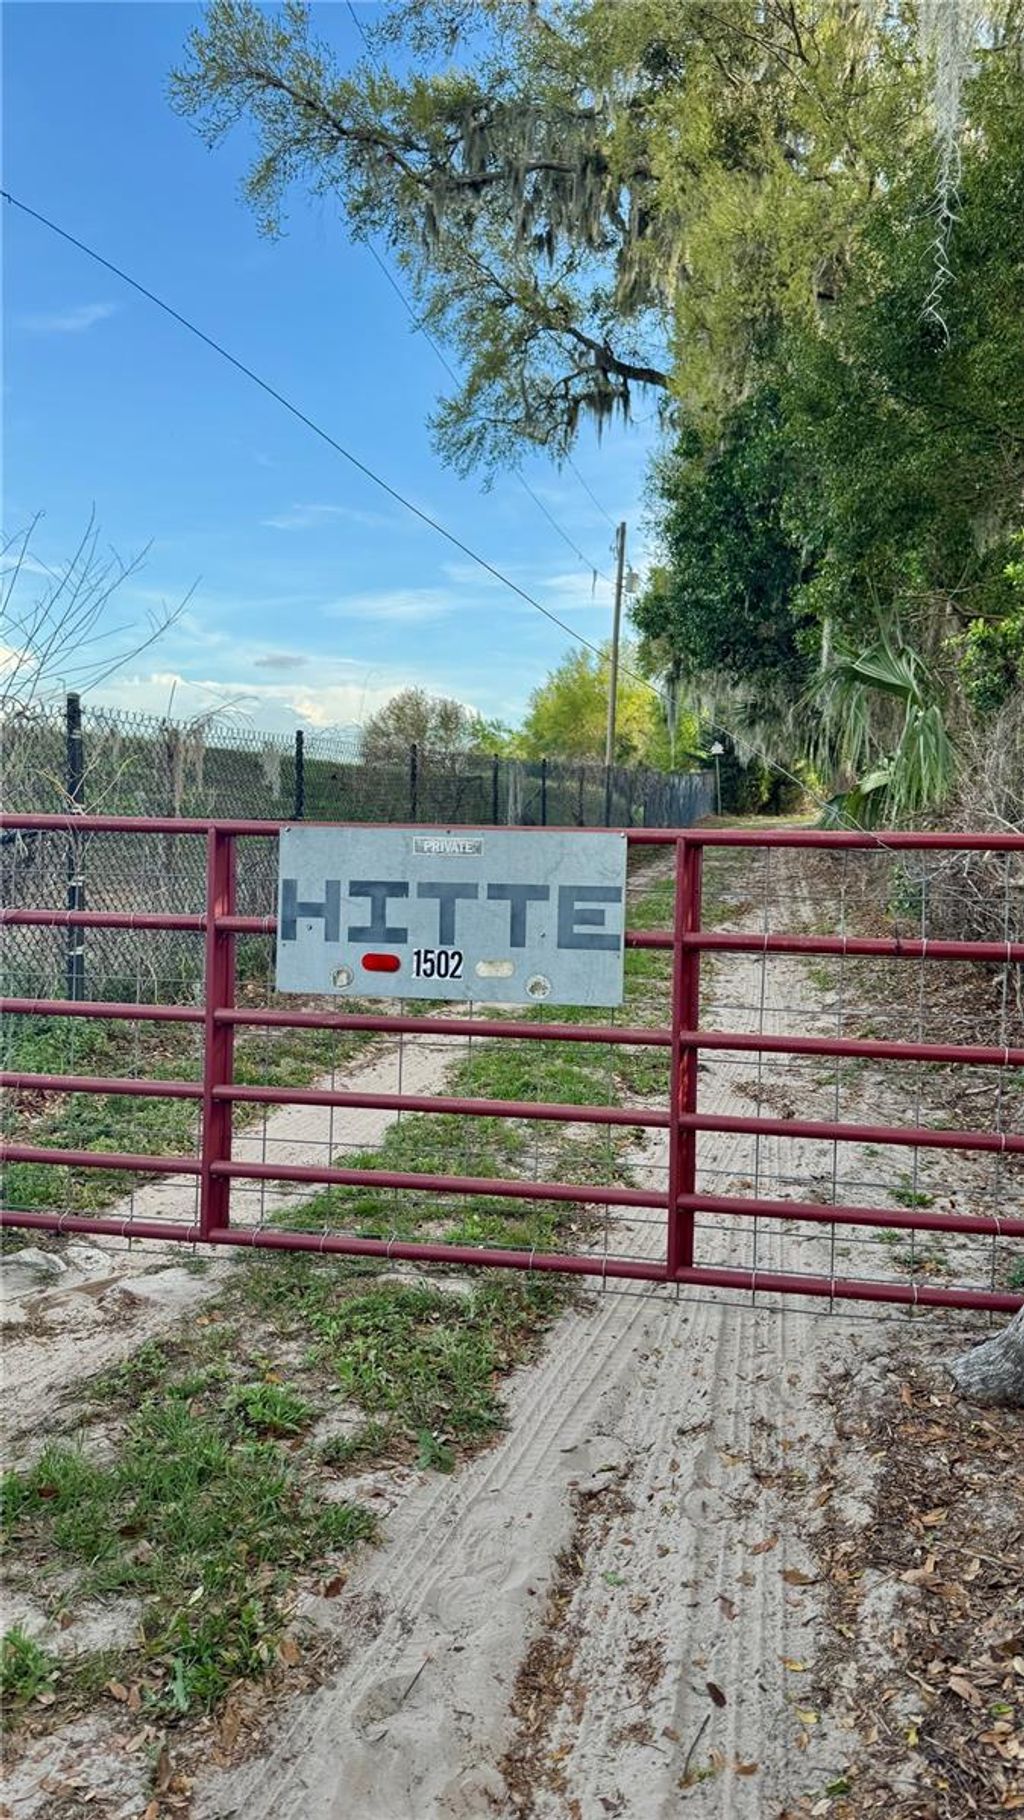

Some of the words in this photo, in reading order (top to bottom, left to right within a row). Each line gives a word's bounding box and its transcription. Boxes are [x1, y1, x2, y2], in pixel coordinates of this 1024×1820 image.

[423, 840, 473, 853] PRIVATE
[281, 878, 622, 951] HITTE
[413, 950, 463, 979] 1502
